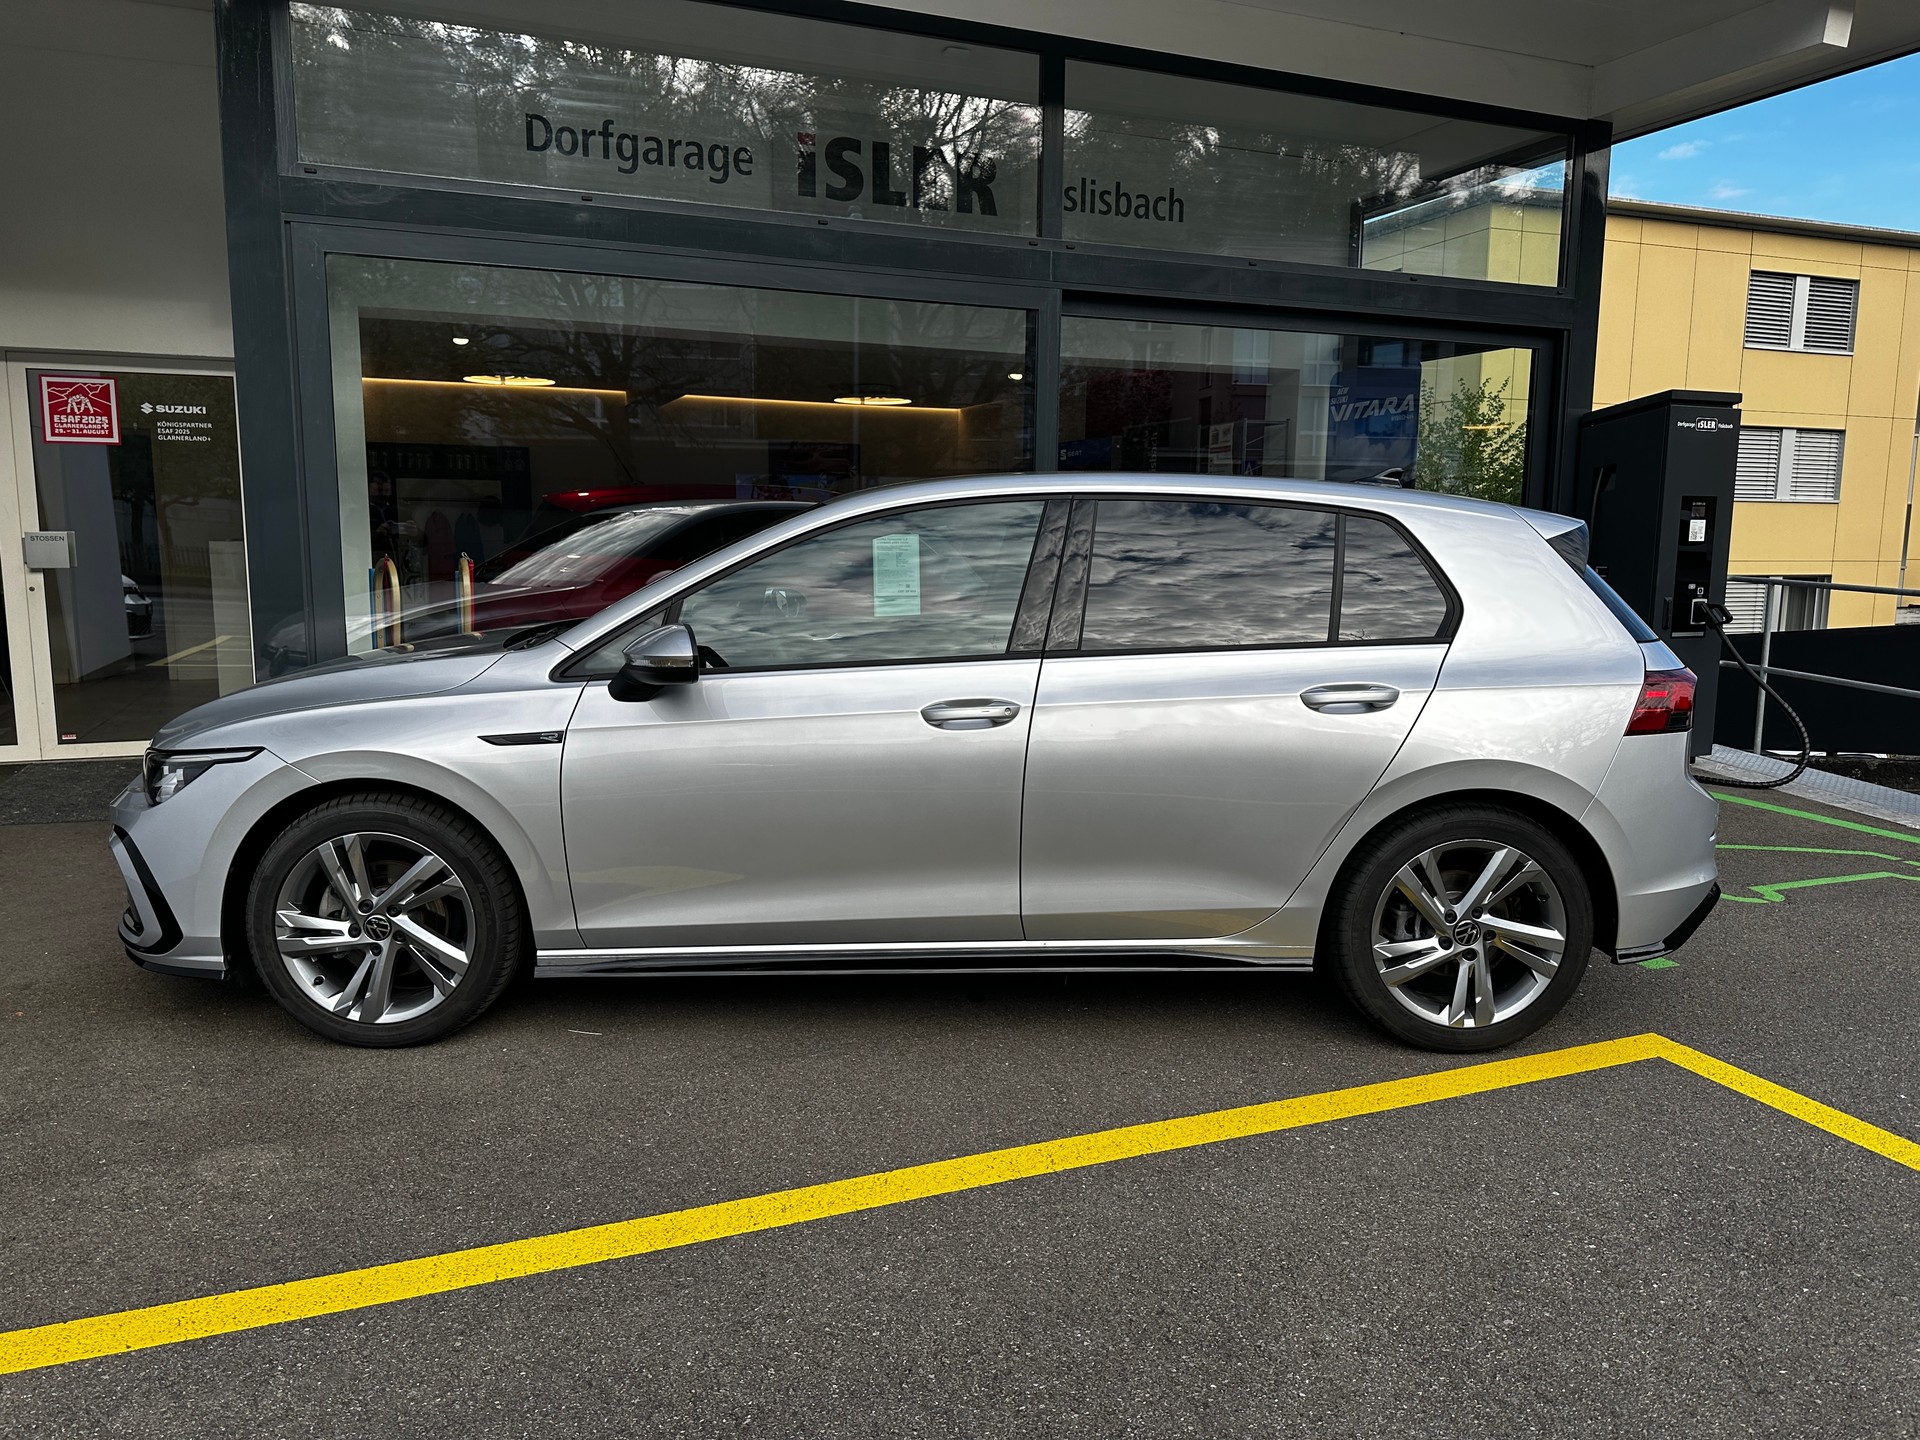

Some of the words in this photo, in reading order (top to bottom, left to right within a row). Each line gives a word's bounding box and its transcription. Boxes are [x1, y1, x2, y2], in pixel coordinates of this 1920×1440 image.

[525, 113, 753, 184] Dorfgarage
[1063, 177, 1185, 223] slisbach
[155, 404, 207, 414] SUZUKI
[1330, 393, 1415, 422] VITARA
[53, 414, 81, 424] ESAF
[82, 415, 109, 424] 2025
[157, 421, 213, 429] KÖNIGSPARTNER
